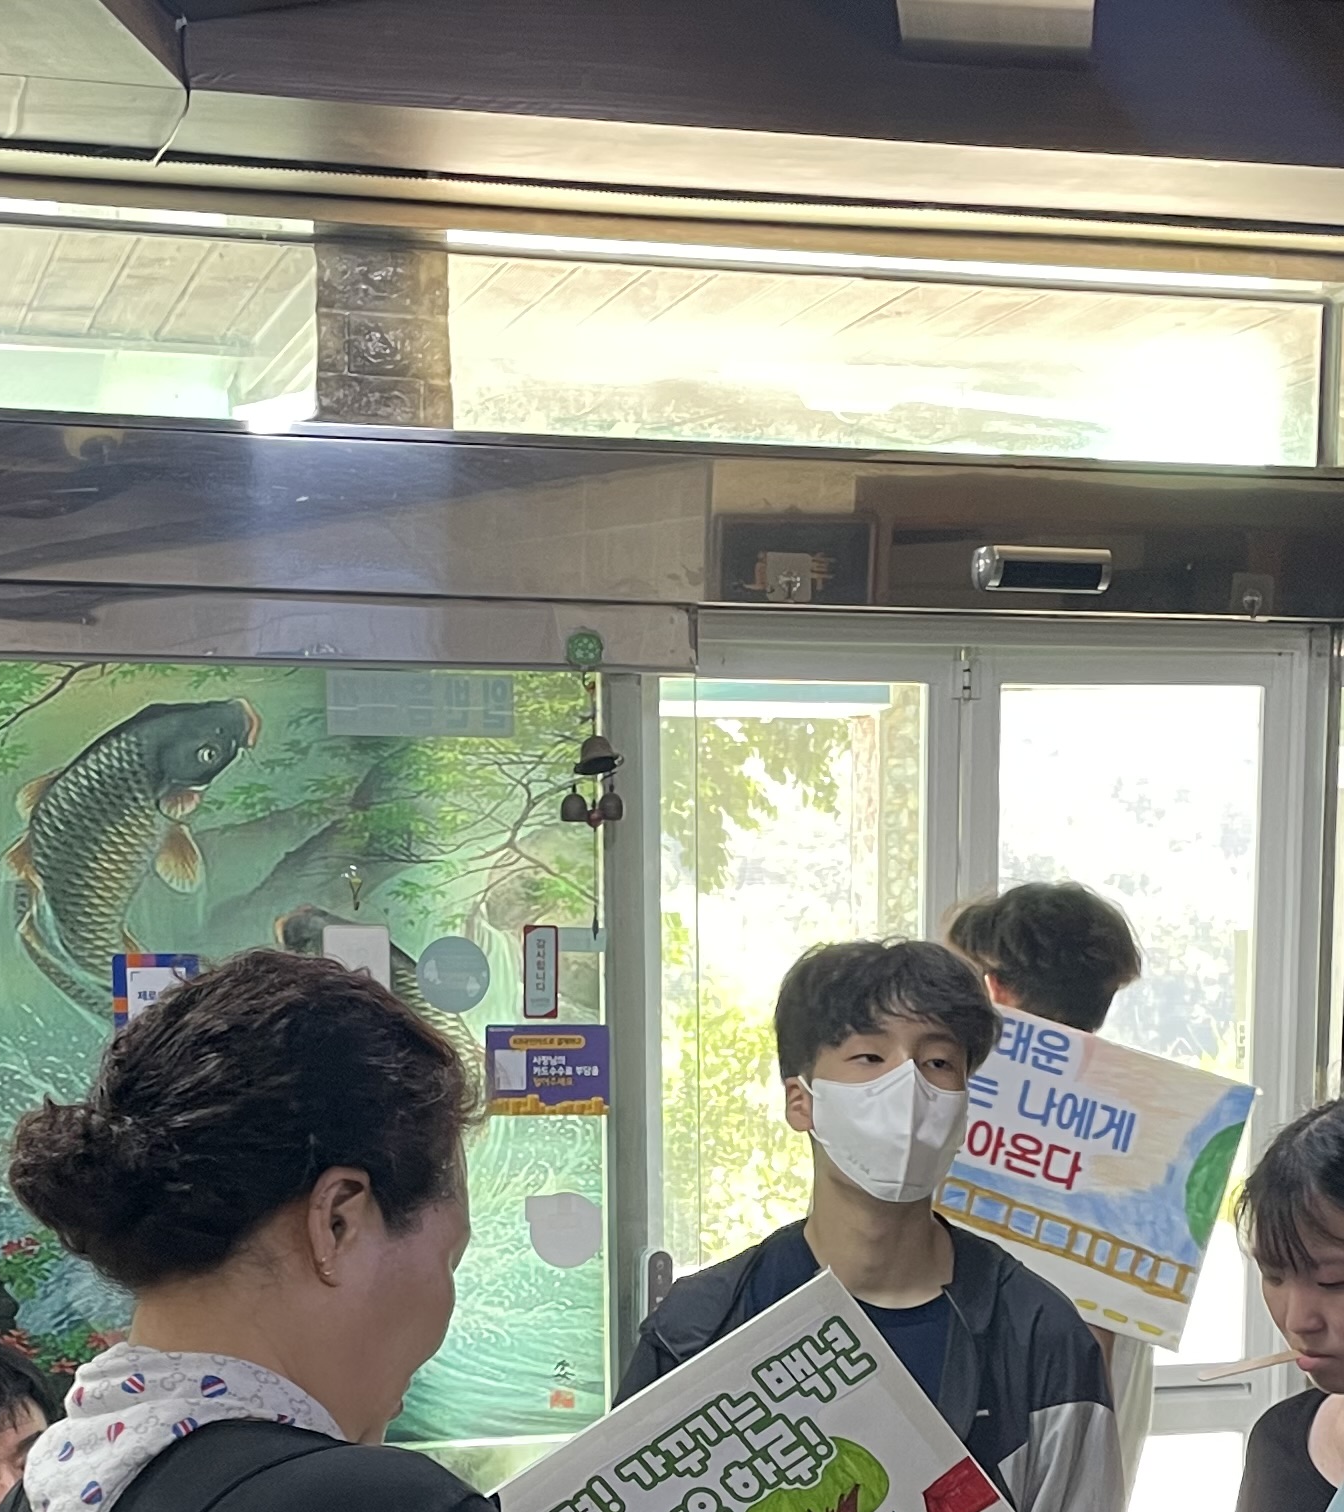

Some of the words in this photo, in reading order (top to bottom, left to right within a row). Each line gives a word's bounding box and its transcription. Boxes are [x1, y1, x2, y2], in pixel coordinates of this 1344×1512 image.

[536, 938, 546, 992] 감사합니다
[1017, 1079, 1136, 1153] 나에게
[967, 1120, 1082, 1190] 아온다
[614, 1391, 771, 1491] 가꾸기는
[752, 1315, 878, 1403] 백년
[720, 1412, 834, 1502] 하루!
